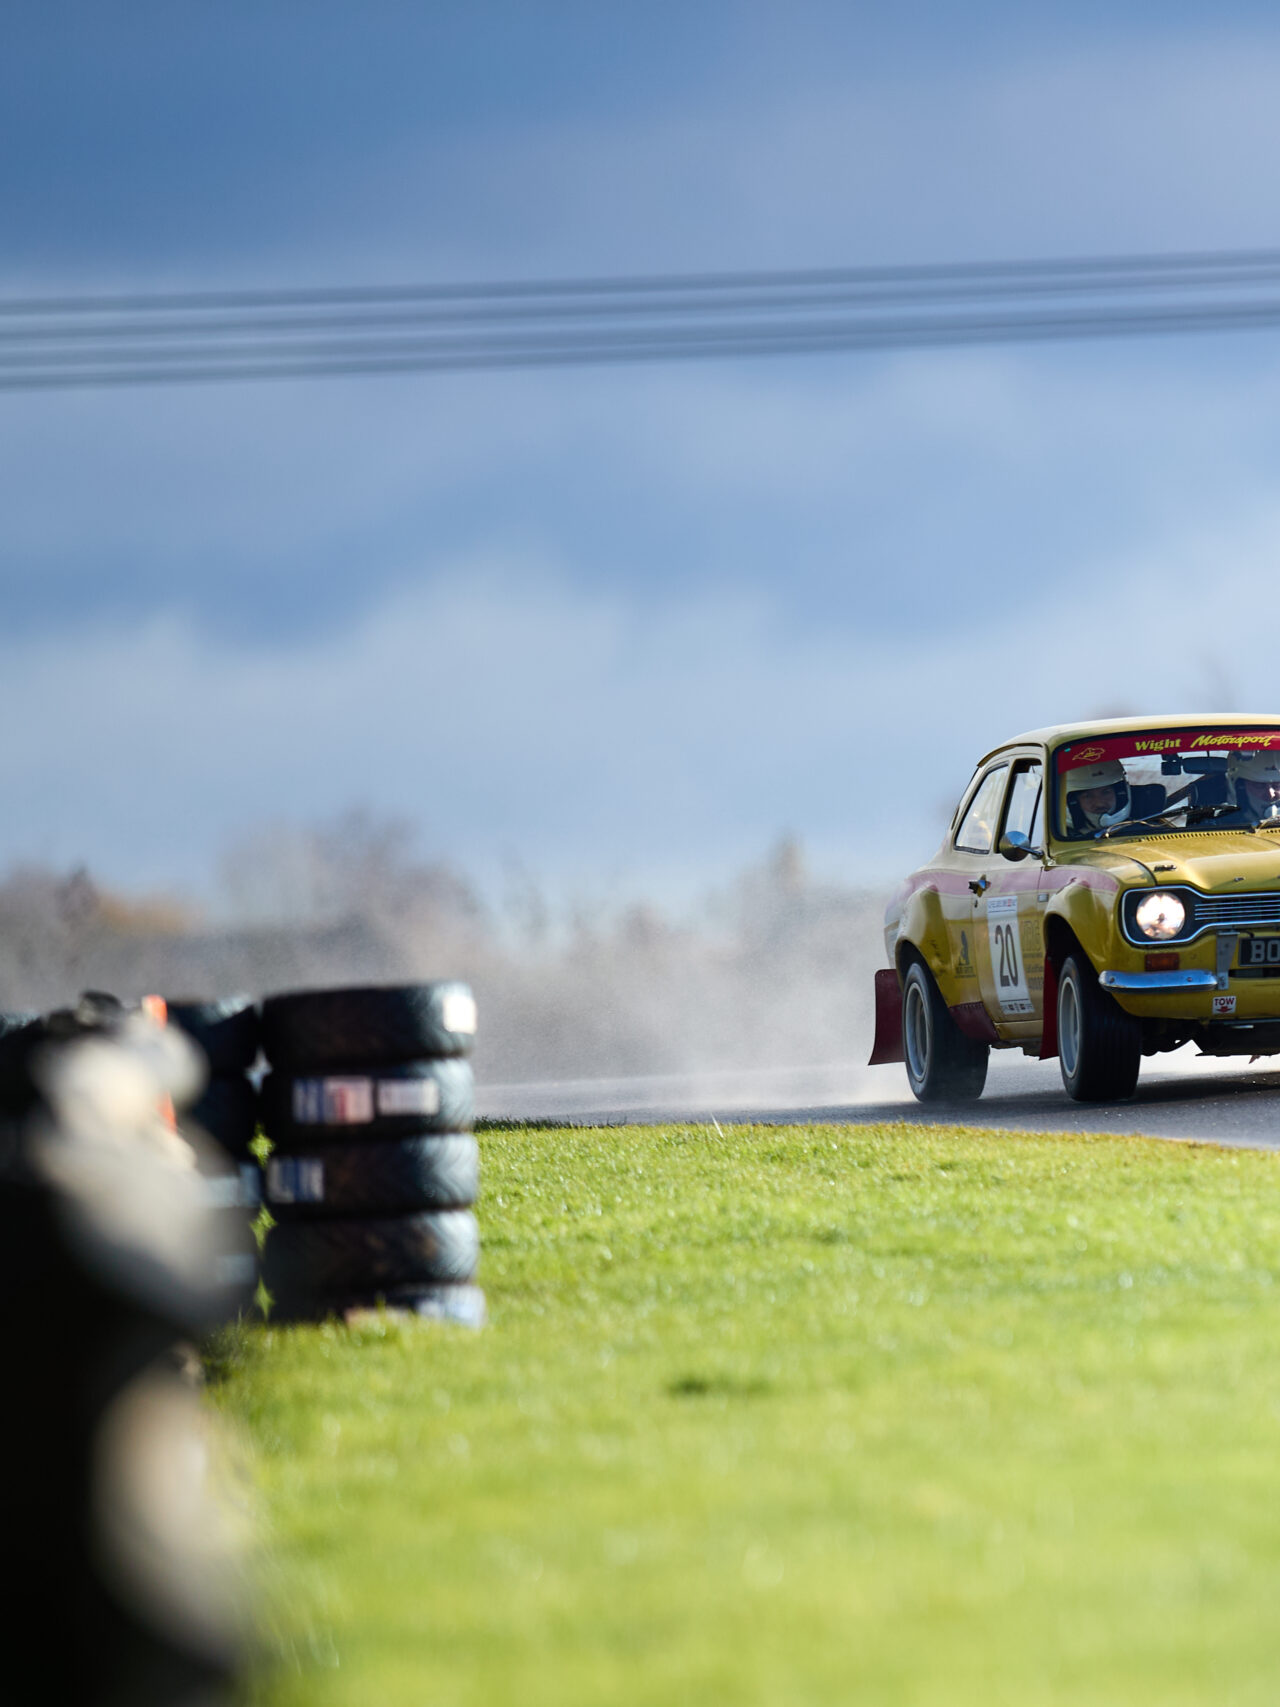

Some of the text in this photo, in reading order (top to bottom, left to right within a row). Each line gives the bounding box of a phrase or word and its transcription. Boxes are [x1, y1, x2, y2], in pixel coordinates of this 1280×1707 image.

[1135, 738, 1181, 751] Wight
[995, 924, 1018, 987] 20
[1214, 997, 1235, 1006] TOW
